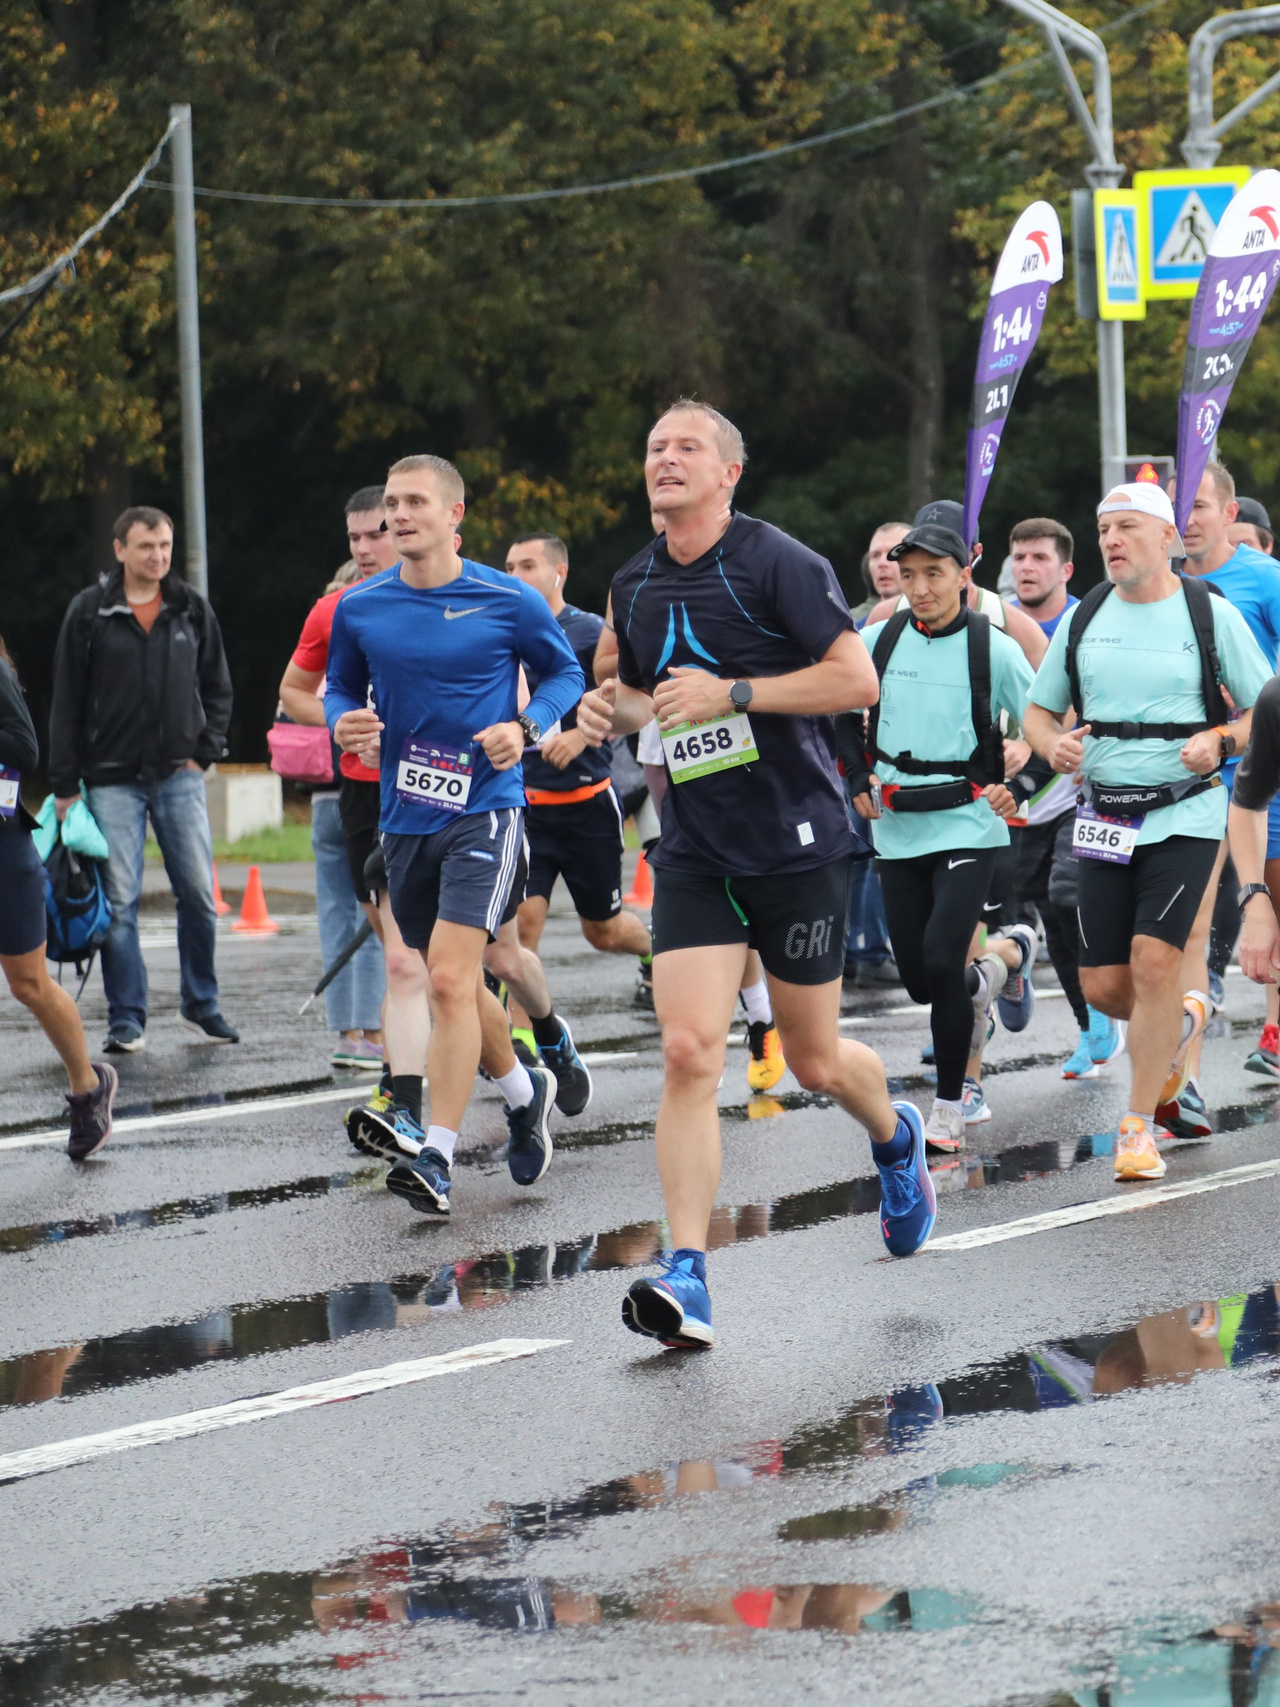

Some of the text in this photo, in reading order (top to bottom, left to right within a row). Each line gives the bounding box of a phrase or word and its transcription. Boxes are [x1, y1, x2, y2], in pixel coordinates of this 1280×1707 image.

[1242, 229, 1265, 249] ANTA
[1021, 253, 1039, 273] ANTA
[1215, 272, 1267, 317] 1:44
[673, 727, 734, 762] 4658
[404, 768, 463, 797] 5670
[1100, 793, 1158, 803] POWERUP
[1077, 825, 1121, 847] 6546
